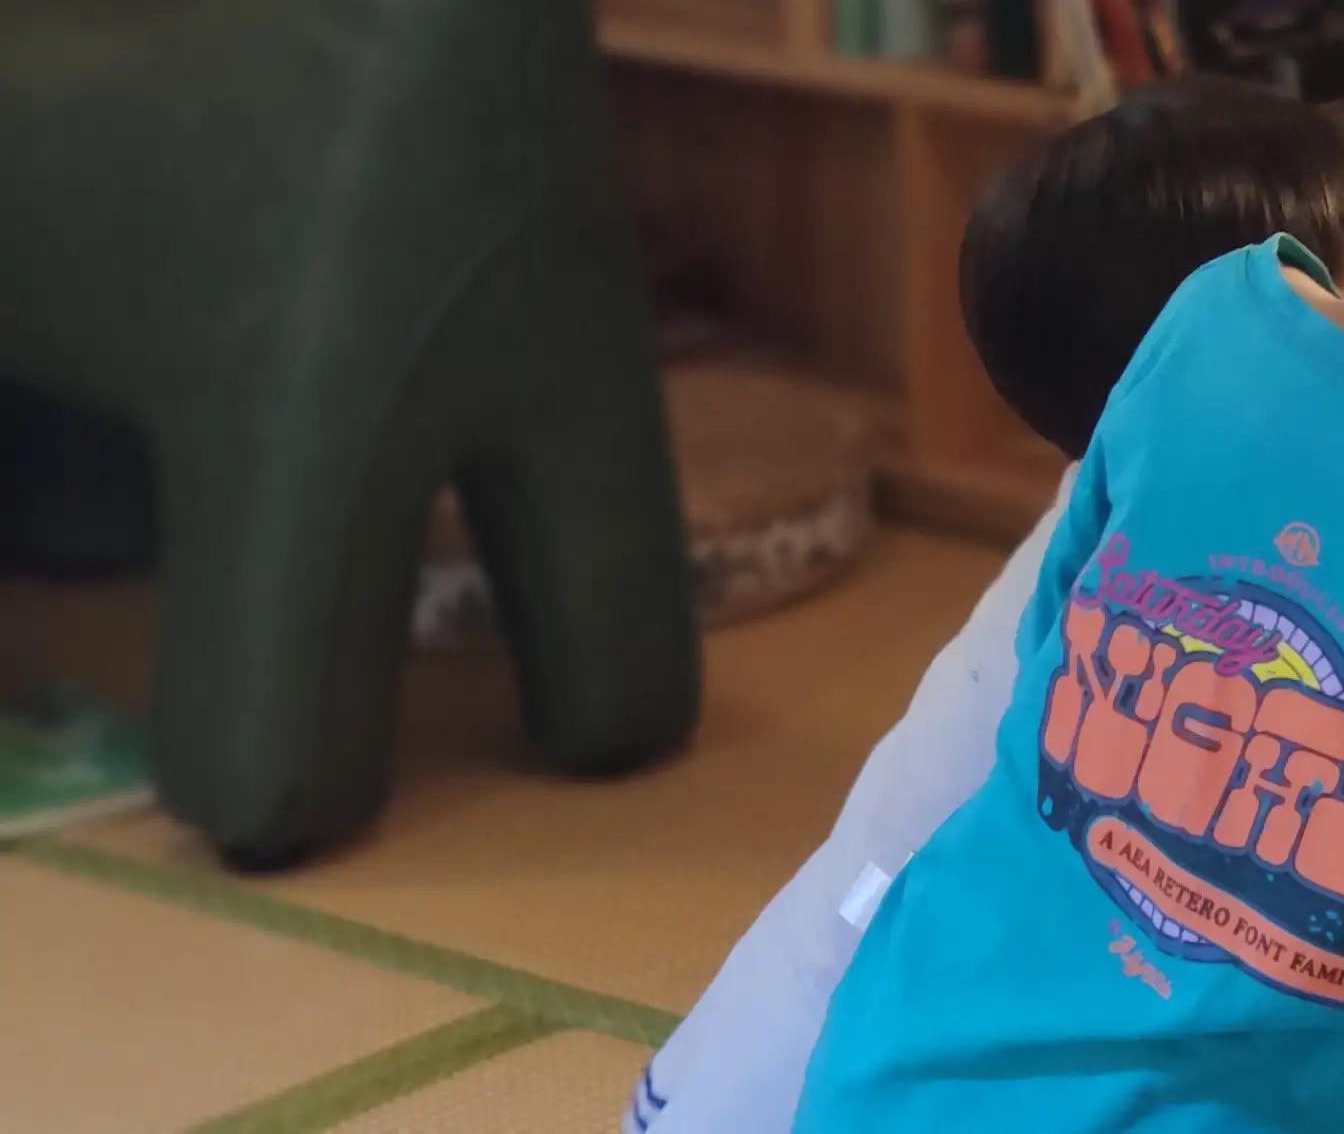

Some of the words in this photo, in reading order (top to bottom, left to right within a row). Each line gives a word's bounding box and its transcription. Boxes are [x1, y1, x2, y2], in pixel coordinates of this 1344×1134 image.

[1070, 530, 1282, 678] Saturday
[1099, 830, 1114, 851] A
[1153, 867, 1231, 928] RETERO
[1232, 917, 1288, 963] FONT
